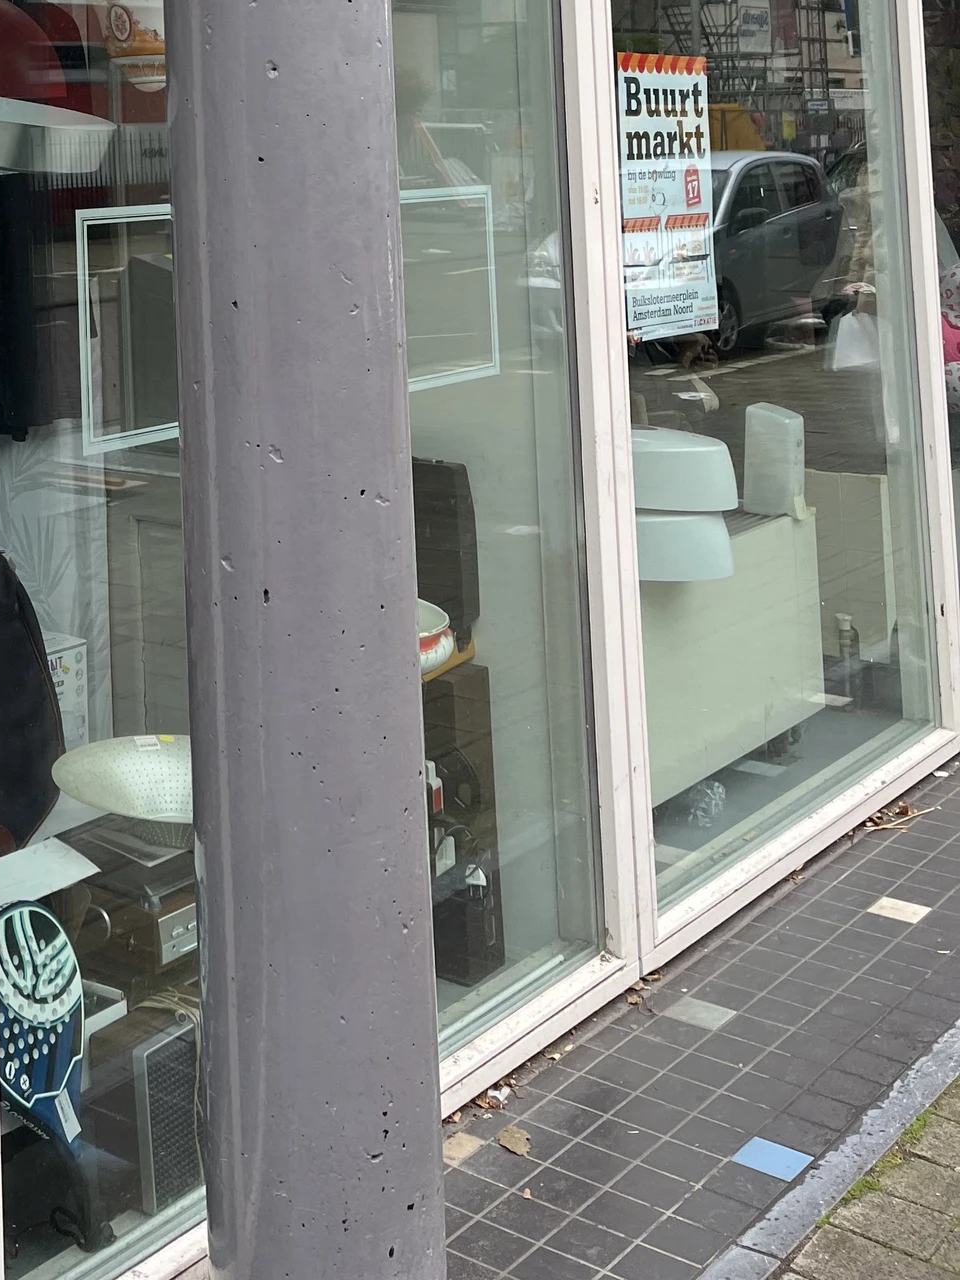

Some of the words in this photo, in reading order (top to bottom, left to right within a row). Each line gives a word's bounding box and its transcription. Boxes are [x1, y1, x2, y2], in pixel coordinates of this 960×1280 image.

[624, 76, 704, 118] Buurt
[625, 120, 706, 161] markt
[627, 169, 637, 183] bij
[638, 168, 646, 180] de
[648, 169, 676, 182] bowling
[687, 181, 698, 198] 17
[632, 289, 699, 308] Buikslotermeerplein
[632, 307, 672, 321] Amsterdam
[673, 302, 693, 316] Noord
